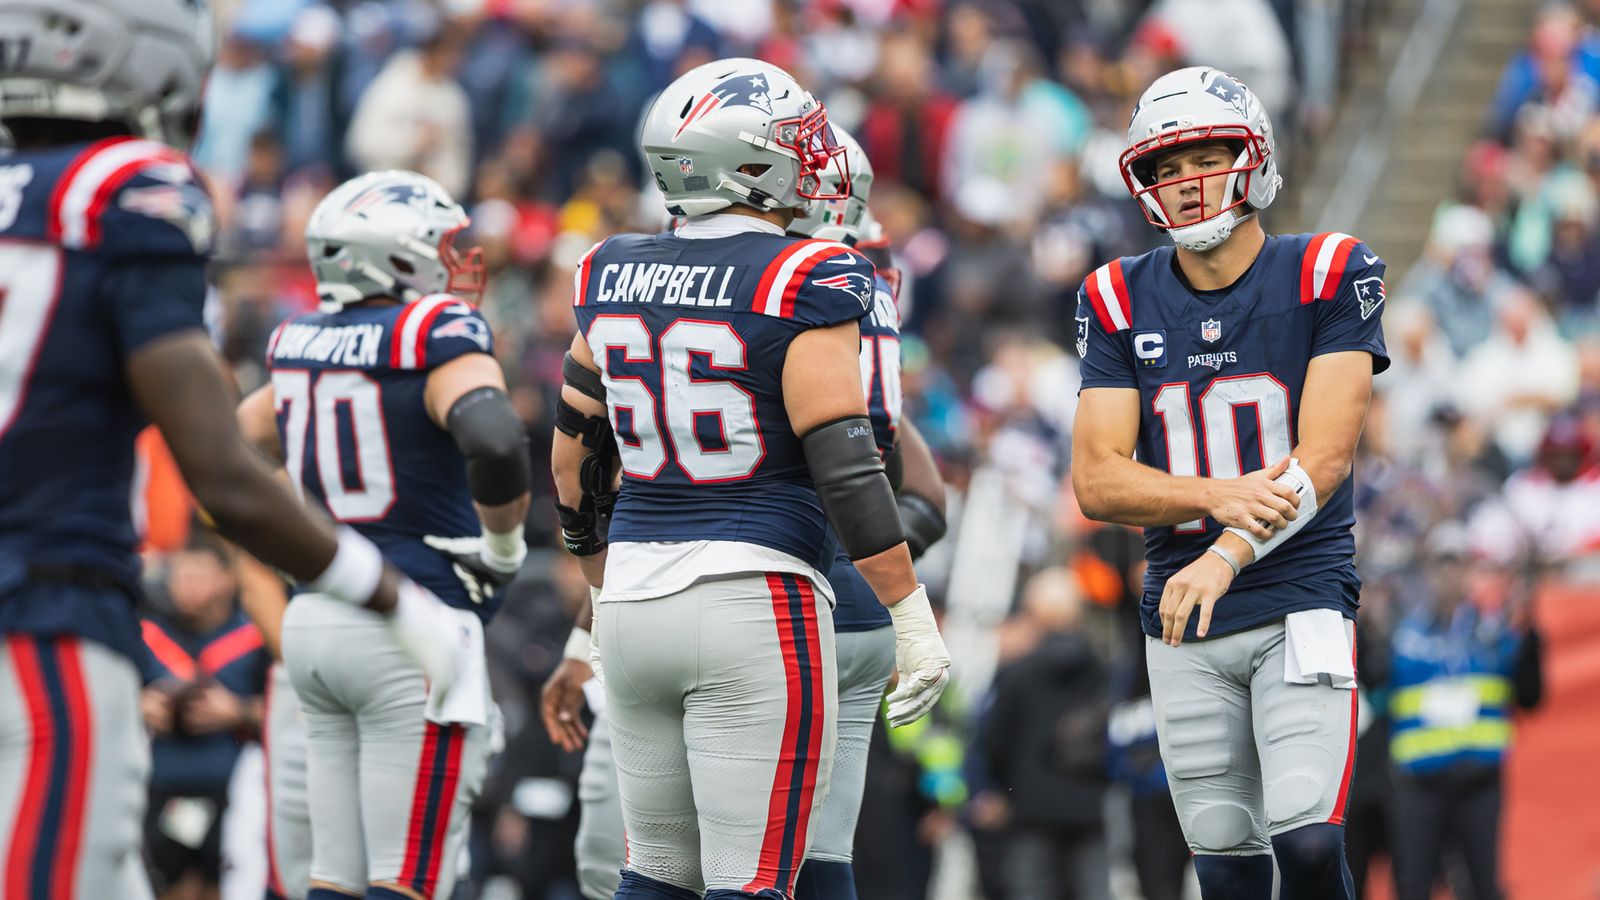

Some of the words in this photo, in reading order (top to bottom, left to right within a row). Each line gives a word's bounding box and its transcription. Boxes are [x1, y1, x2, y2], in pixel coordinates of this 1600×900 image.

[596, 262, 735, 307] CAMPBELL
[1134, 333, 1164, 360] C
[1187, 351, 1238, 369] PATRIOTS
[270, 368, 399, 523] 70
[586, 313, 767, 485] 66
[1152, 371, 1296, 535] 10
